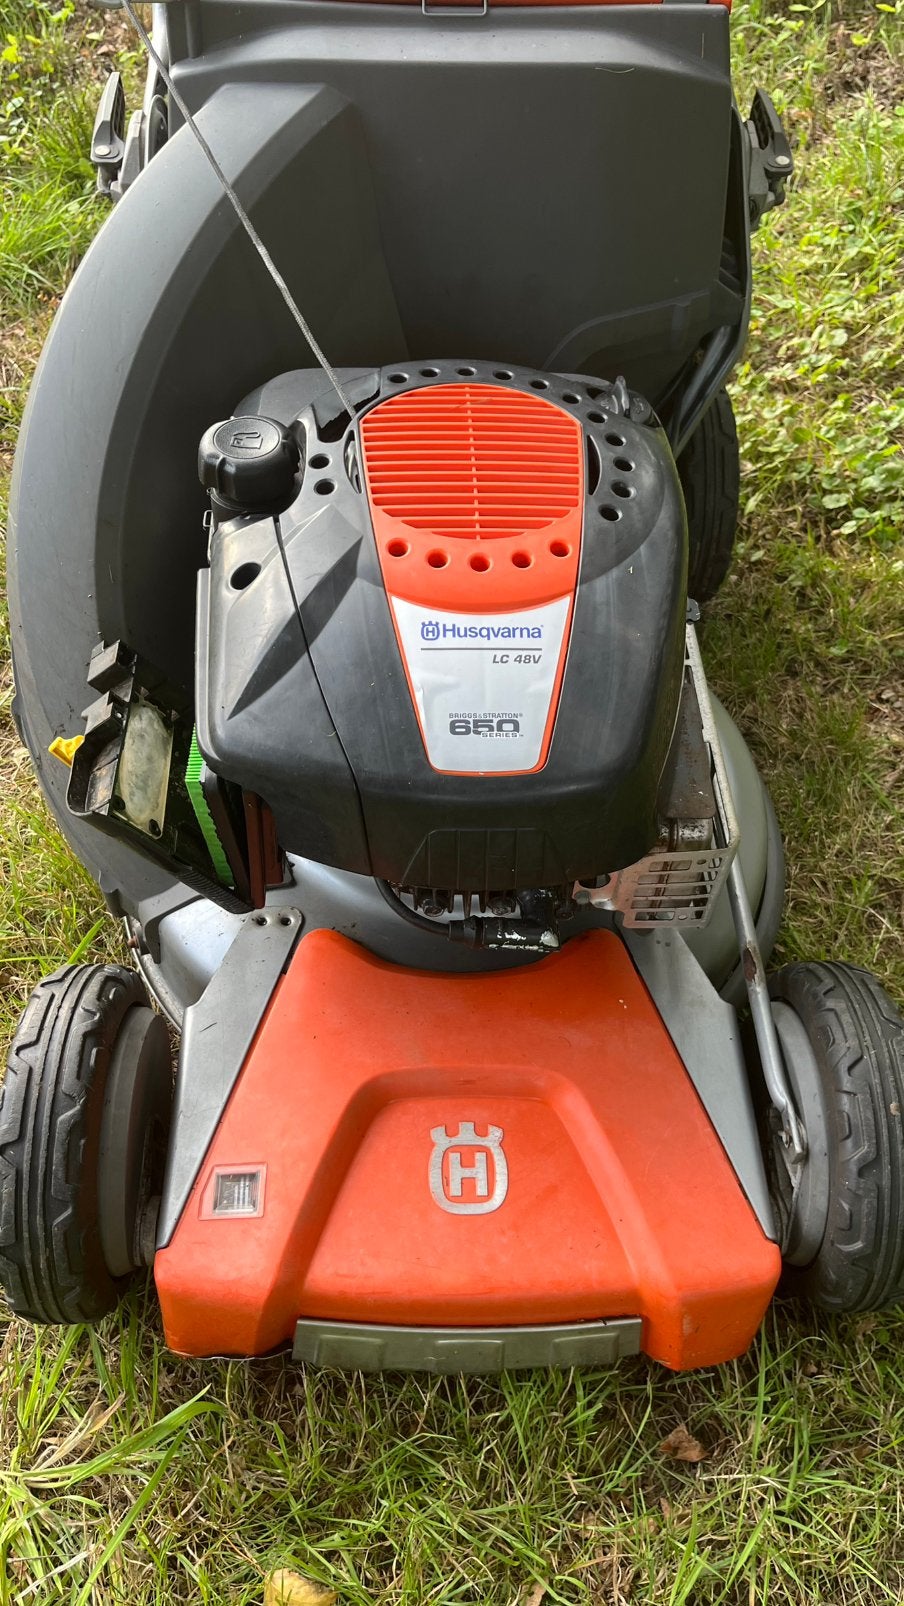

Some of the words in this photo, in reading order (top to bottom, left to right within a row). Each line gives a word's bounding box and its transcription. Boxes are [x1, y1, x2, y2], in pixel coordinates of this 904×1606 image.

[442, 623, 542, 640] Husqvarna
[492, 654, 510, 664] LC
[513, 654, 542, 664] 48V
[449, 719, 520, 735] 650
